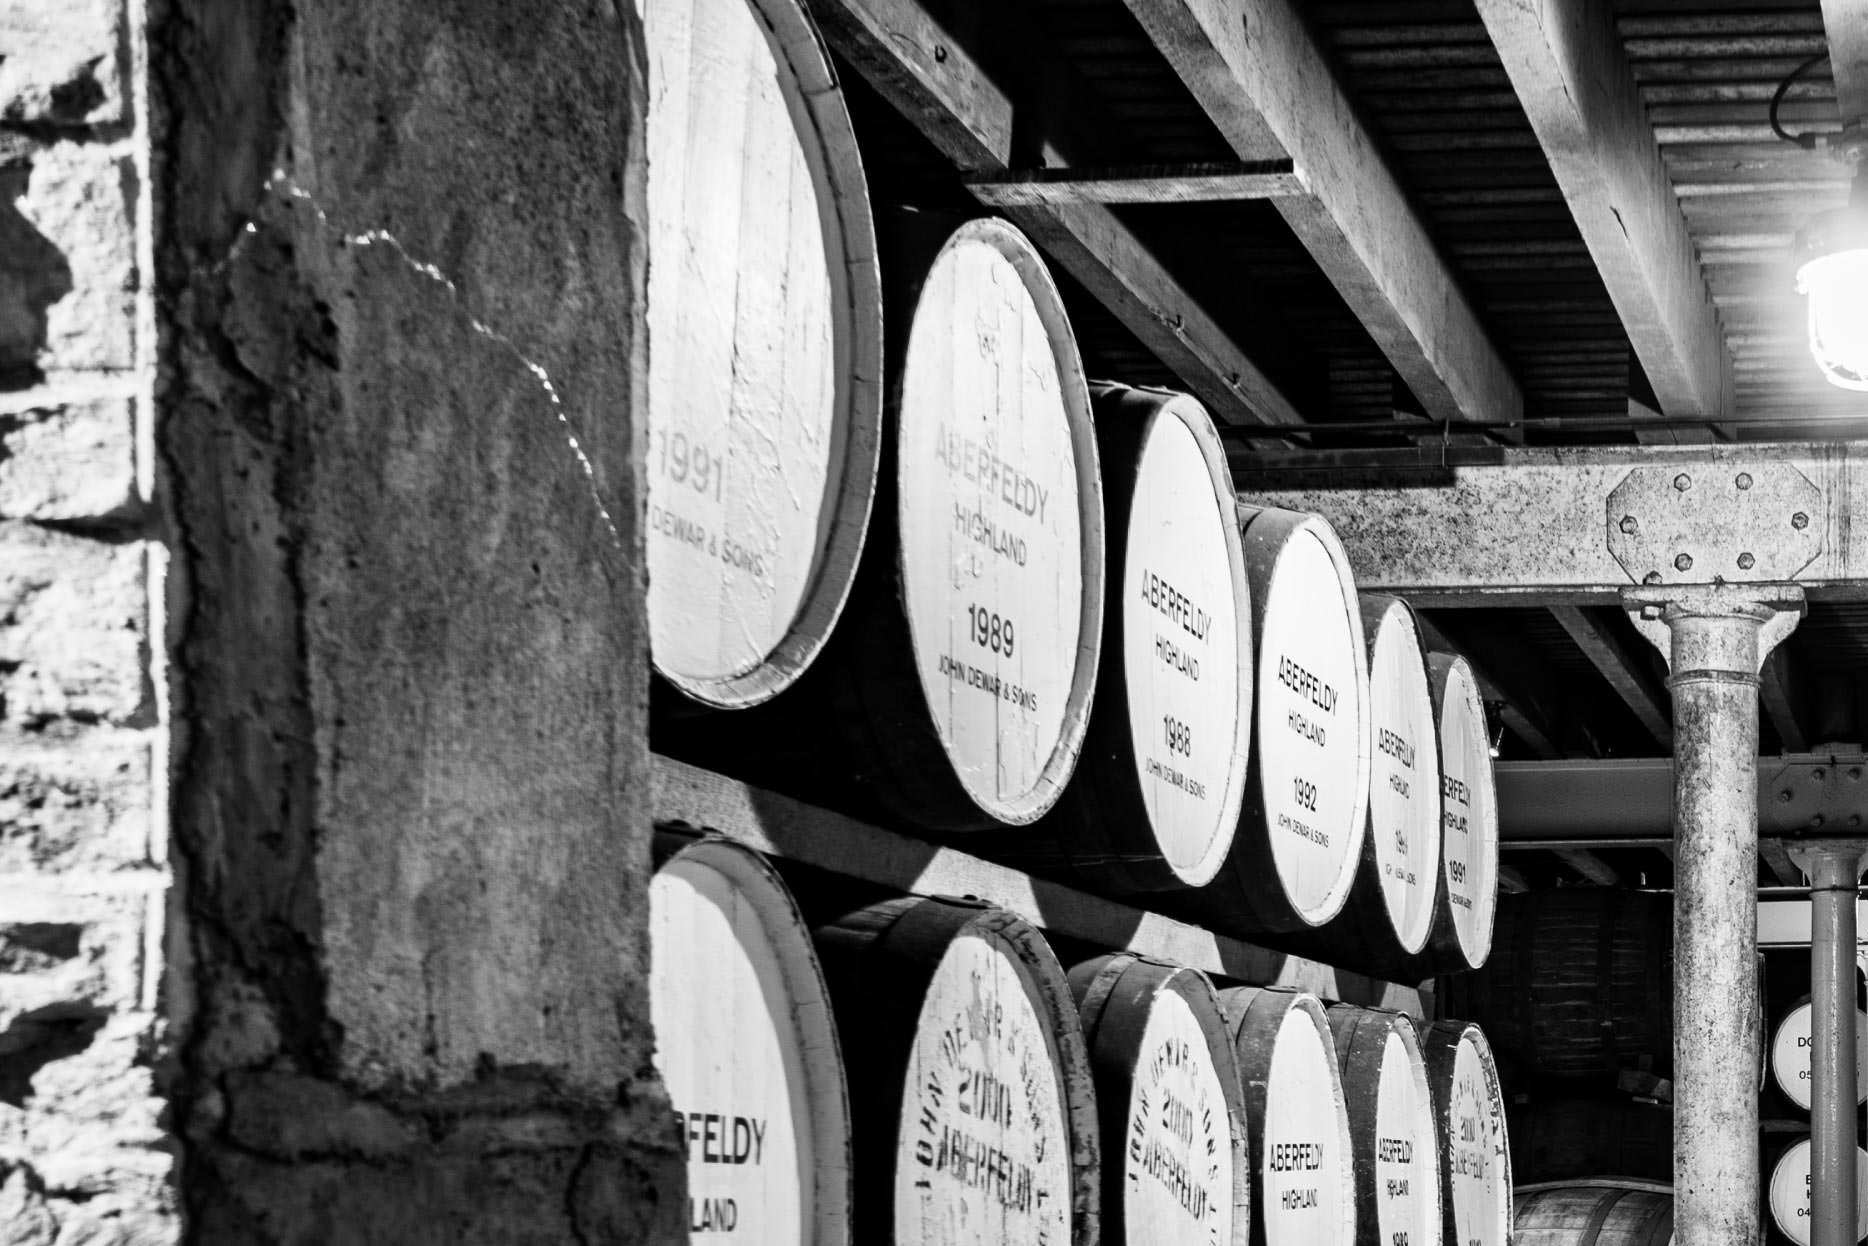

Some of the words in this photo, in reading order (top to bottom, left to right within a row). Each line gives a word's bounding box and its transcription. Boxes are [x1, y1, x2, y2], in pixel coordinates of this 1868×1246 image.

[659, 428, 722, 504] 1991
[936, 421, 1048, 525] ABERFELDY
[652, 505, 705, 552] DEWAR
[722, 537, 764, 577] SONS
[954, 500, 1027, 568] HIGHLAND
[968, 602, 1014, 659] 1989
[1142, 568, 1211, 645] ABERFELDY
[939, 654, 966, 682] JOHN
[968, 666, 1001, 698] DEWAR
[1012, 685, 1038, 712] SONS
[1156, 632, 1200, 681] HIGHLAND
[1279, 654, 1338, 716] ABERFELDY
[1163, 714, 1191, 757] 1988
[1289, 708, 1325, 748] HIGHLAND
[1294, 776, 1317, 812] 1992
[687, 1112, 767, 1166] FELDY
[1270, 1143, 1323, 1171] ABERFELDY
[690, 1198, 738, 1233] LAND
[1282, 1188, 1318, 1210] HIGHLAND
